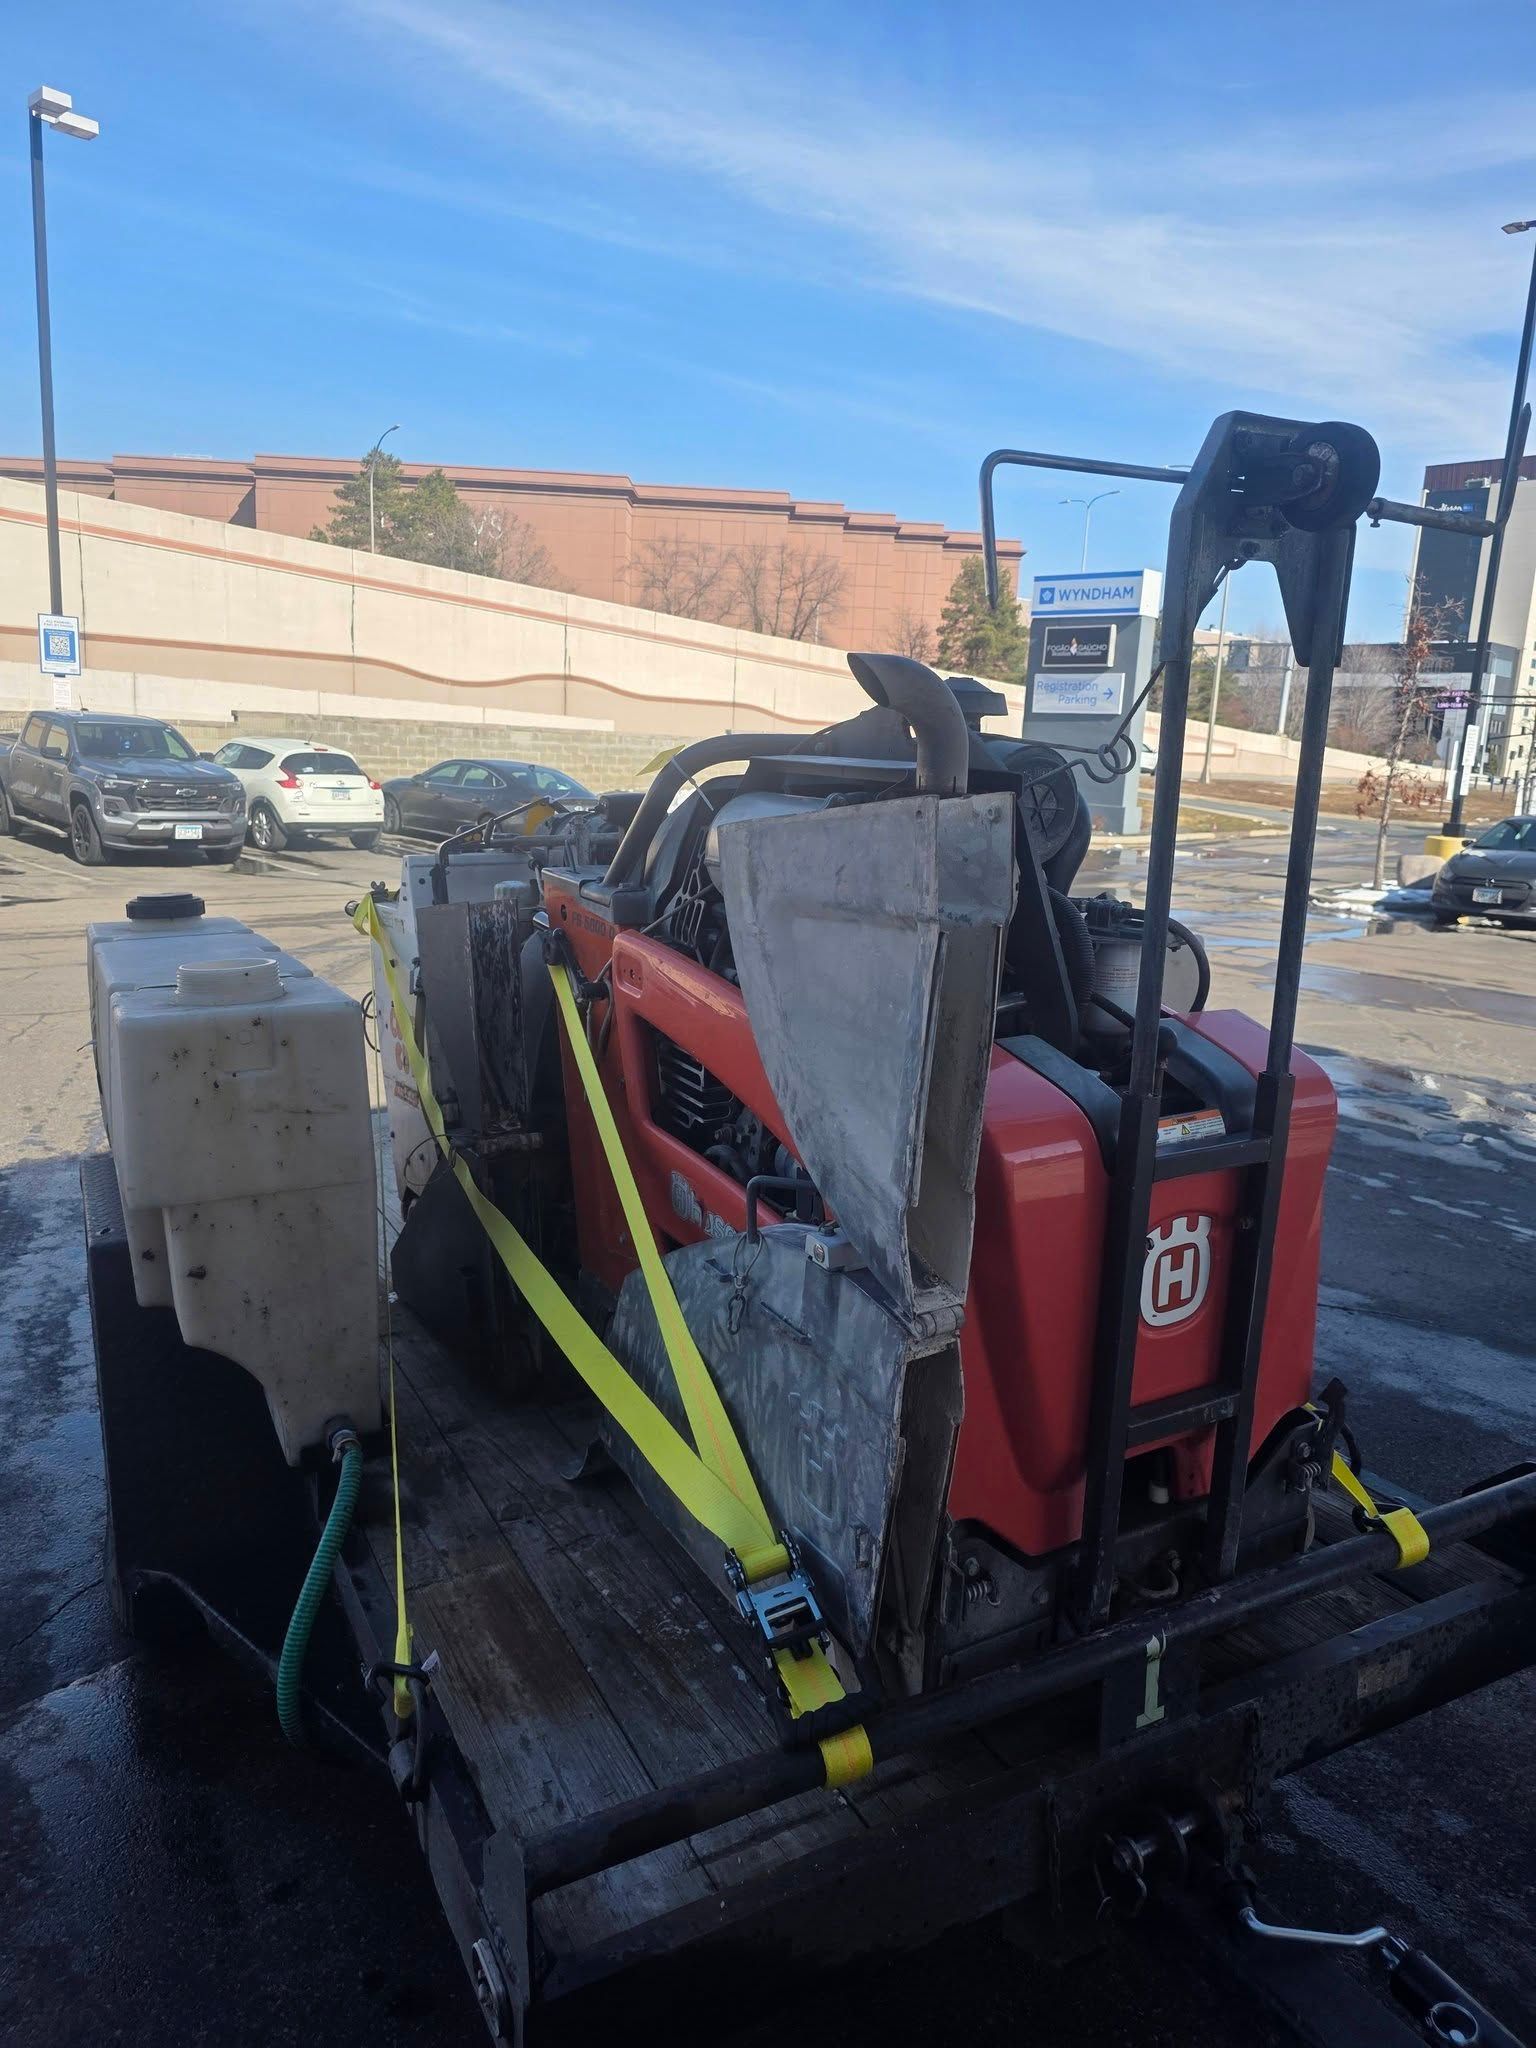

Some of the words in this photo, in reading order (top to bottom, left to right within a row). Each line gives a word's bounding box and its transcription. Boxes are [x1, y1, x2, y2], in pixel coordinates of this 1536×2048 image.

[1059, 586, 1134, 601] WYNDHAM
[1036, 680, 1098, 693] Registration
[1058, 694, 1097, 706] Parking
[1158, 1248, 1194, 1307] H
